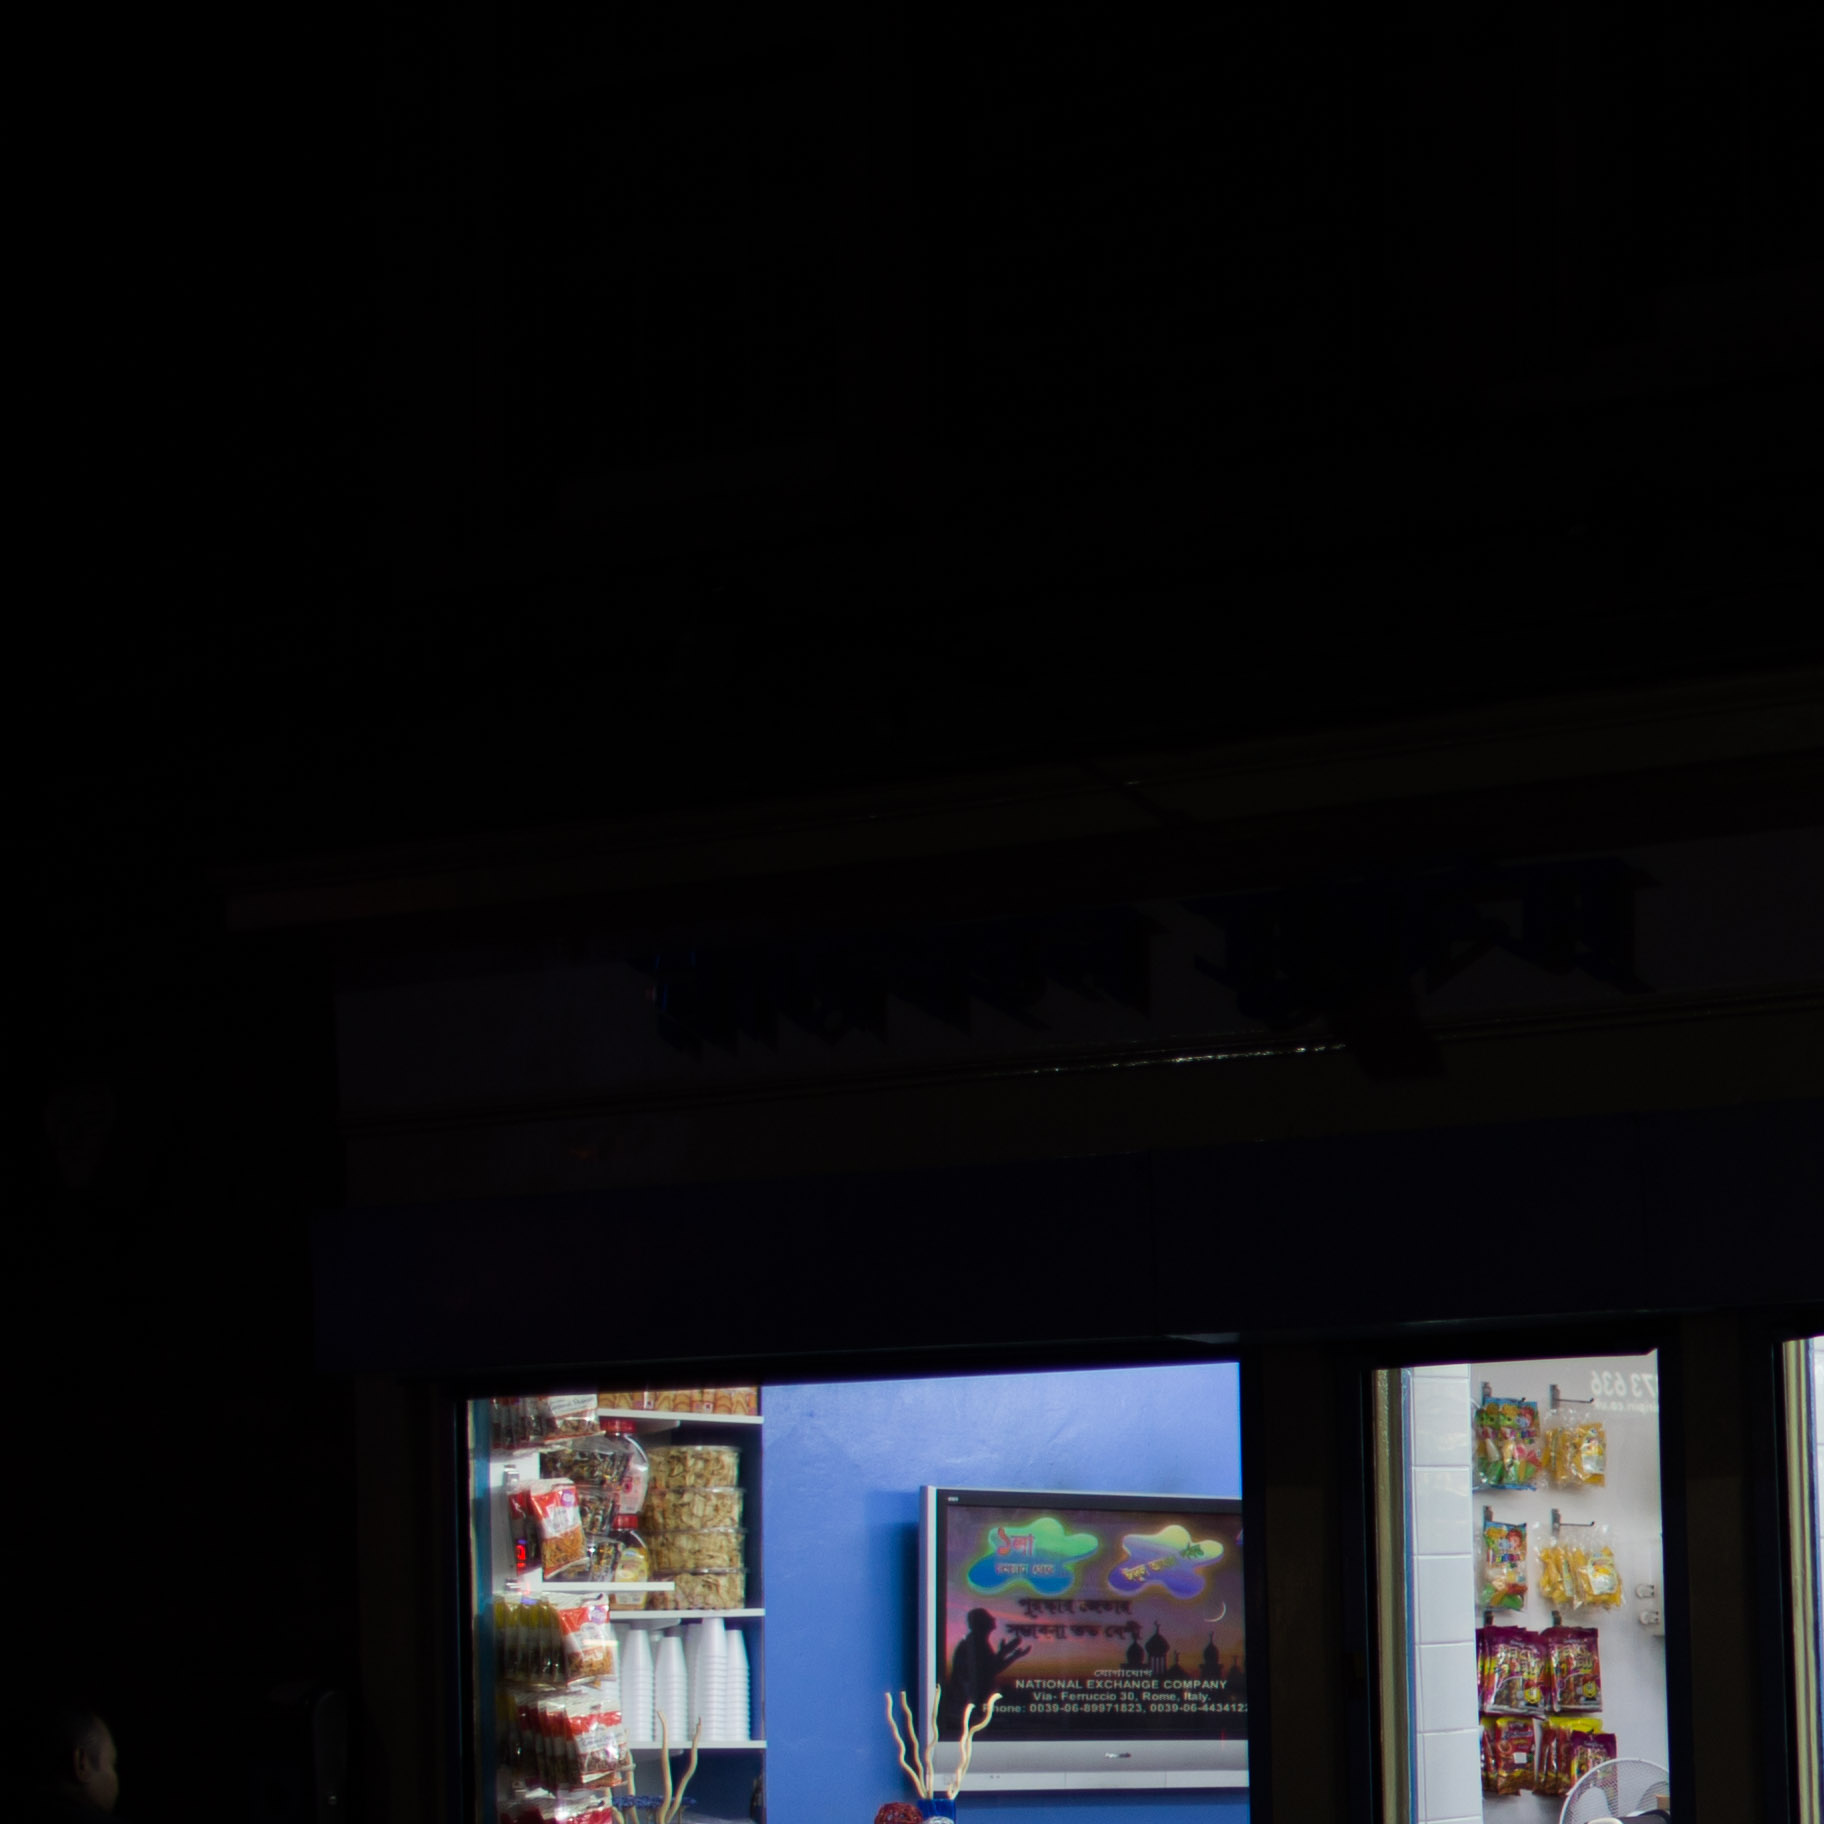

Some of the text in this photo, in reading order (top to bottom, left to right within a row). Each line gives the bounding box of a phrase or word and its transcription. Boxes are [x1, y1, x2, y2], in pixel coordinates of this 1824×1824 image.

[1016, 1679, 1228, 1690] NATIONAL EXCHANGE COMPANY
[1032, 1691, 1058, 1701] Via-
[1060, 1691, 1117, 1702] Ferruccio
[1142, 1692, 1180, 1703] Rome,
[1184, 1692, 1212, 1704] Italy.
